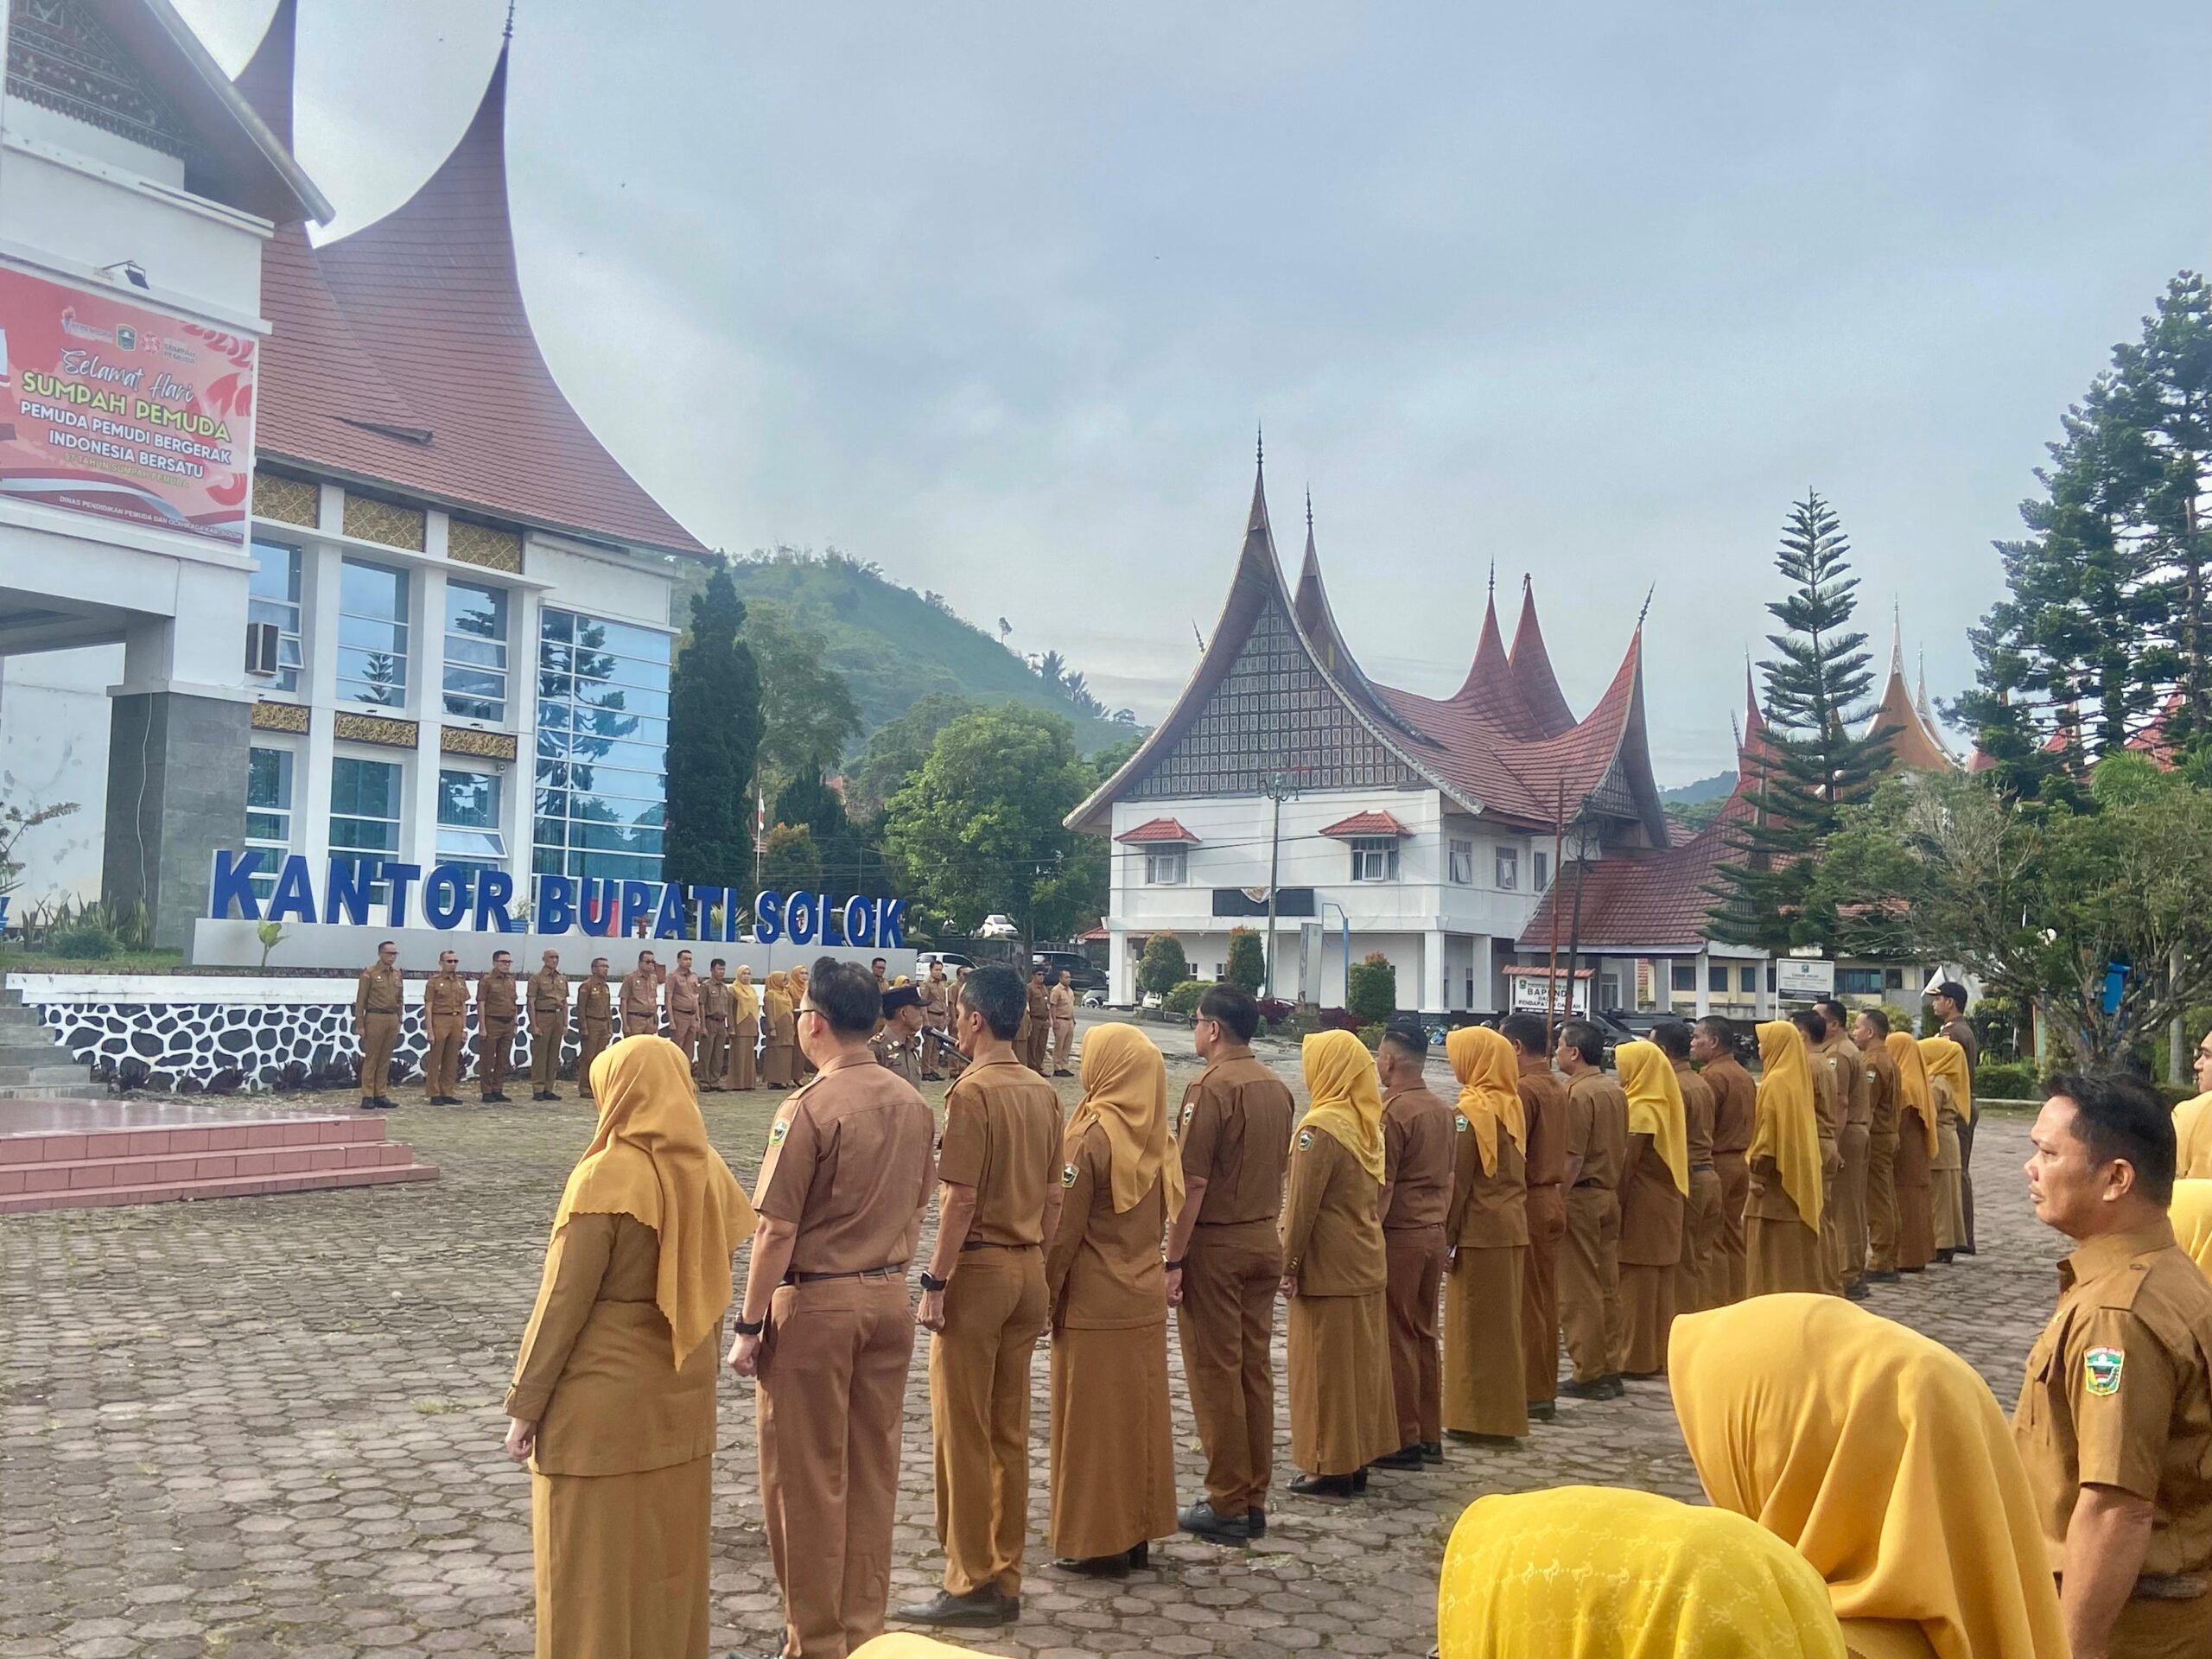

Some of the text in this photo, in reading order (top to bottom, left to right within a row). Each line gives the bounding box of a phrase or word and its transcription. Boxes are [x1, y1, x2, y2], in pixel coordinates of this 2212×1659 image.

[60, 347, 195, 404] Selamat Hari
[20, 400, 231, 464] PEMUDA PEMUDI BERGERAK
[22, 371, 231, 442] SUMPAH PEMUDA
[48, 429, 204, 478] INDONESIA BERSATU
[79, 455, 110, 472] TAHUN
[111, 461, 150, 479] SUMPAH
[151, 472, 189, 488] PEMUDA
[60, 495, 81, 506] DINAS
[82, 500, 124, 515] PENDIDIKAN
[124, 509, 153, 521] PEMUDA
[153, 515, 168, 524] DAN
[207, 849, 906, 949] KANTOR BUPATI SOLOK
[1527, 988, 1574, 998] BAPND
